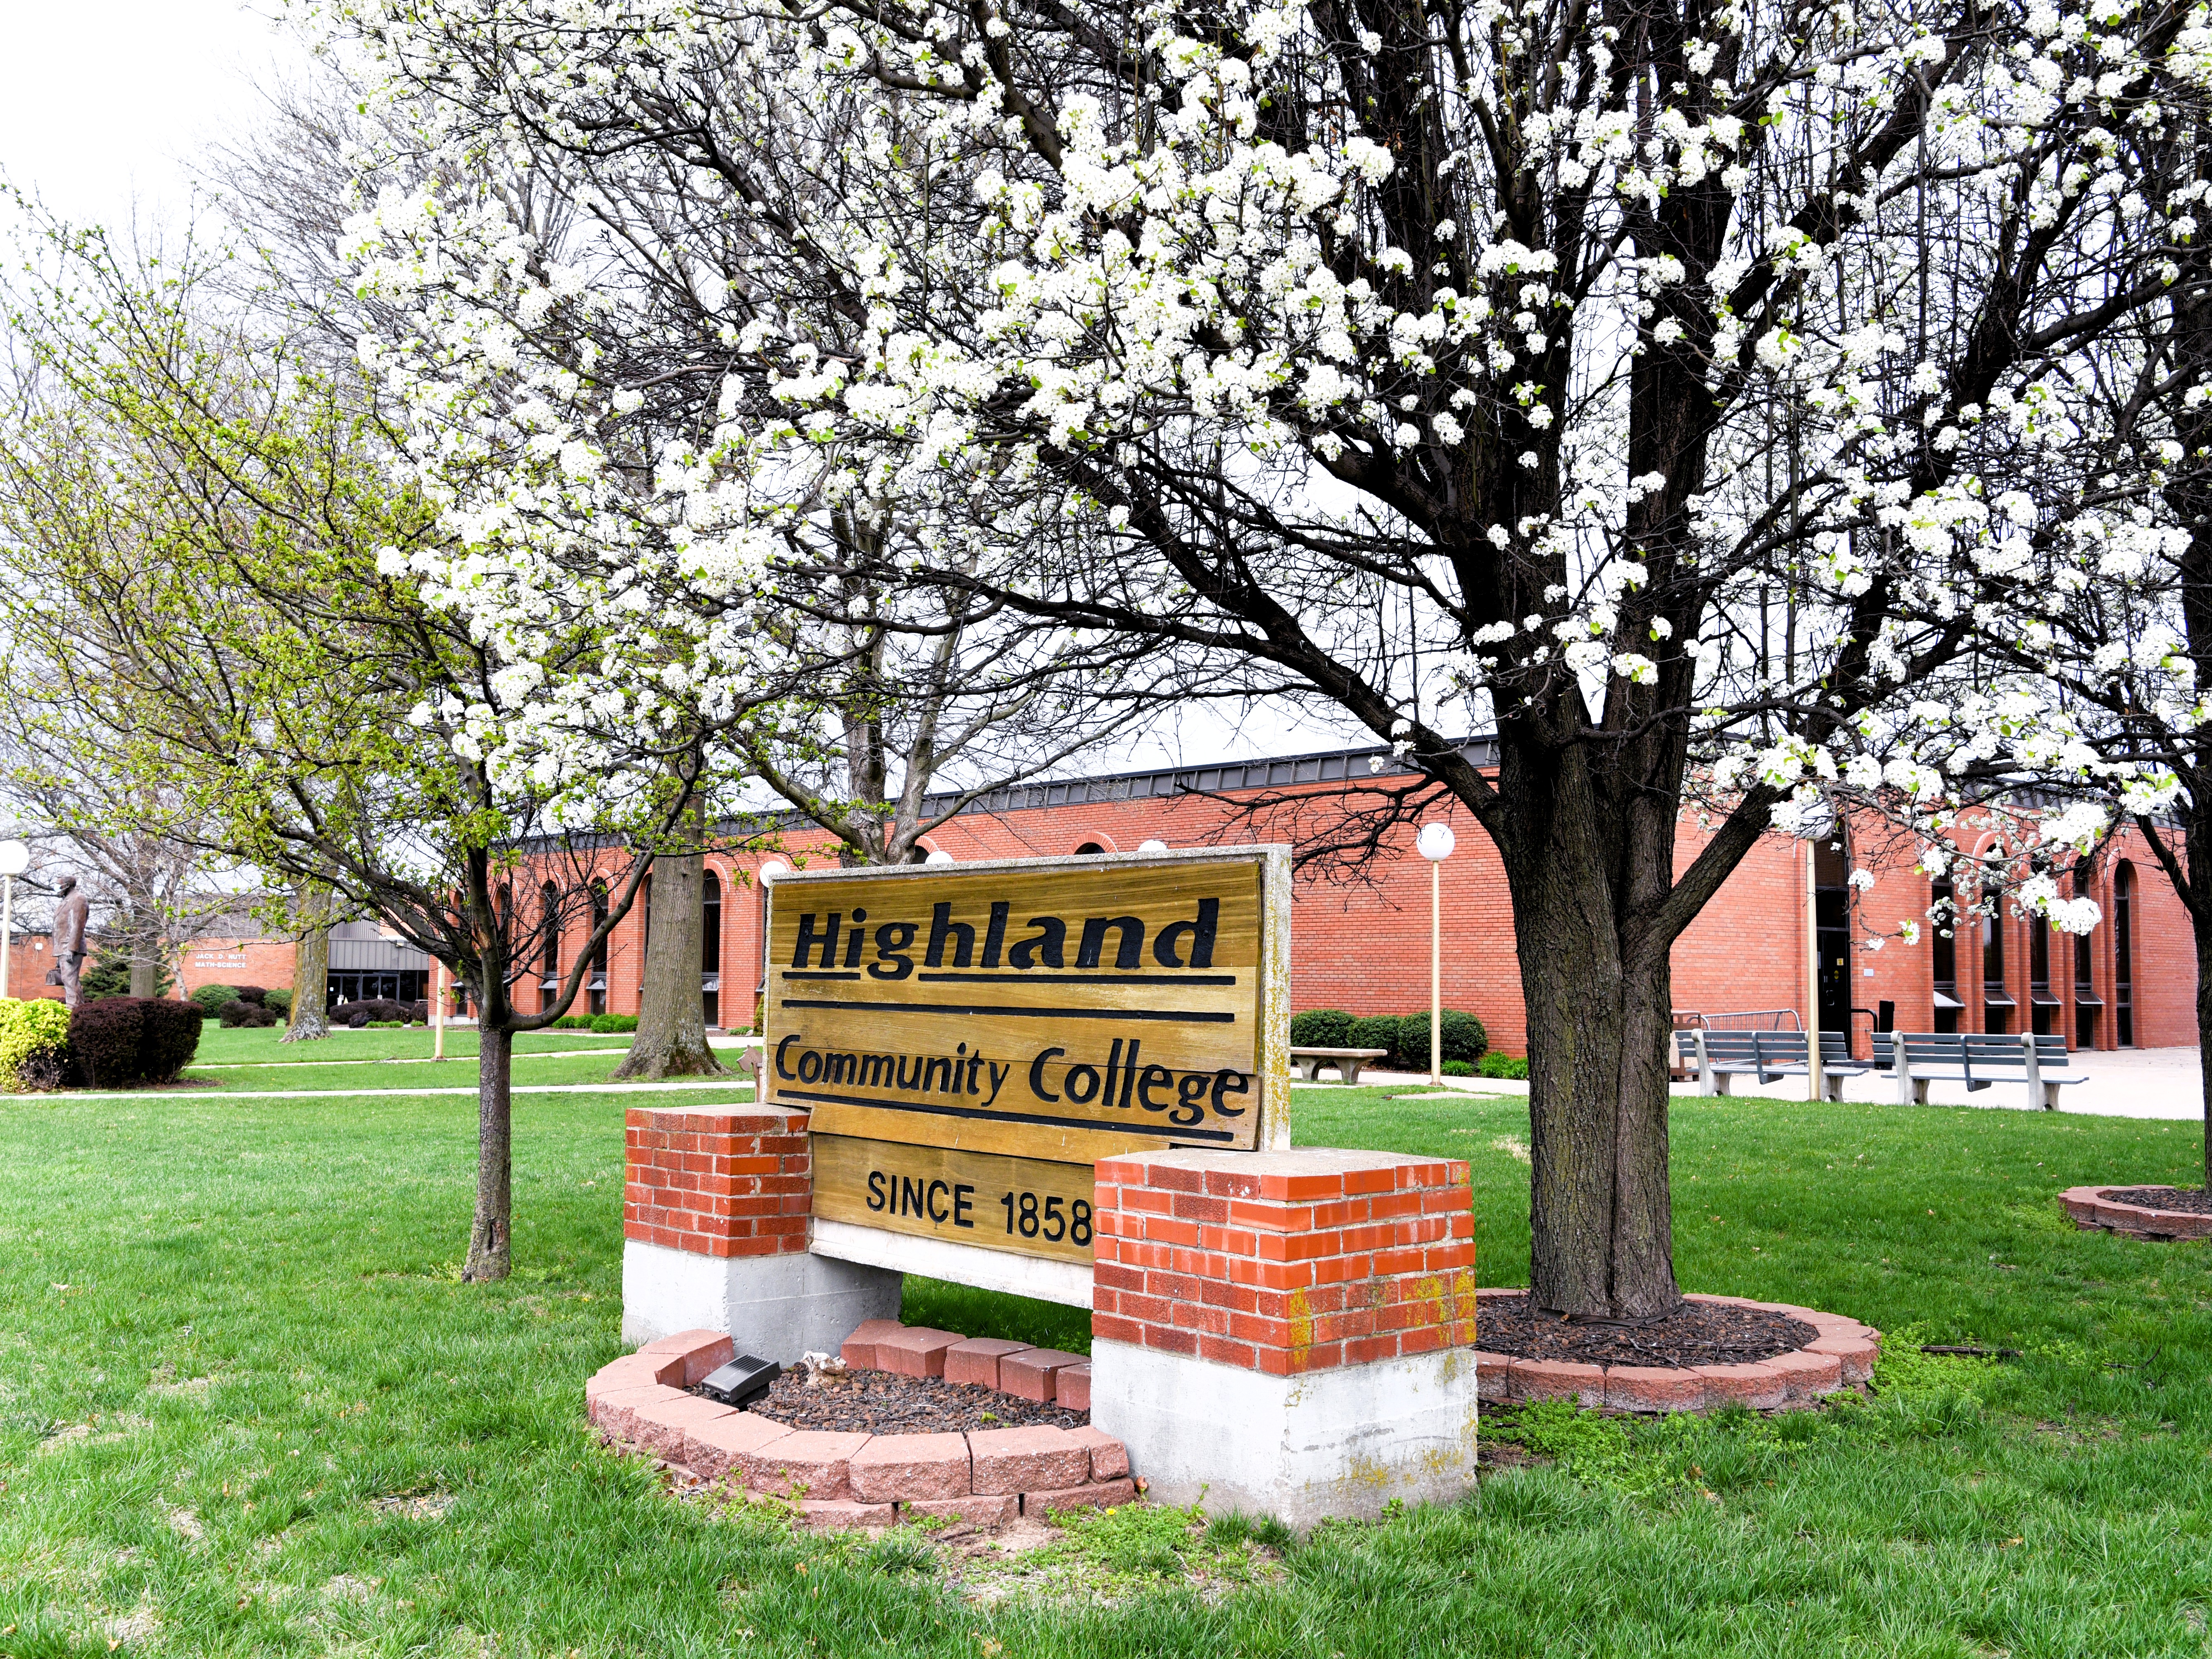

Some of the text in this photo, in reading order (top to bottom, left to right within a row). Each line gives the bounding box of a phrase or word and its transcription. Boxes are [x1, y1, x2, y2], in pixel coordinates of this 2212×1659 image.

[790, 897, 1220, 981] Highland
[775, 1034, 1249, 1127] Community College
[866, 1170, 1093, 1247] SINCE 1858
